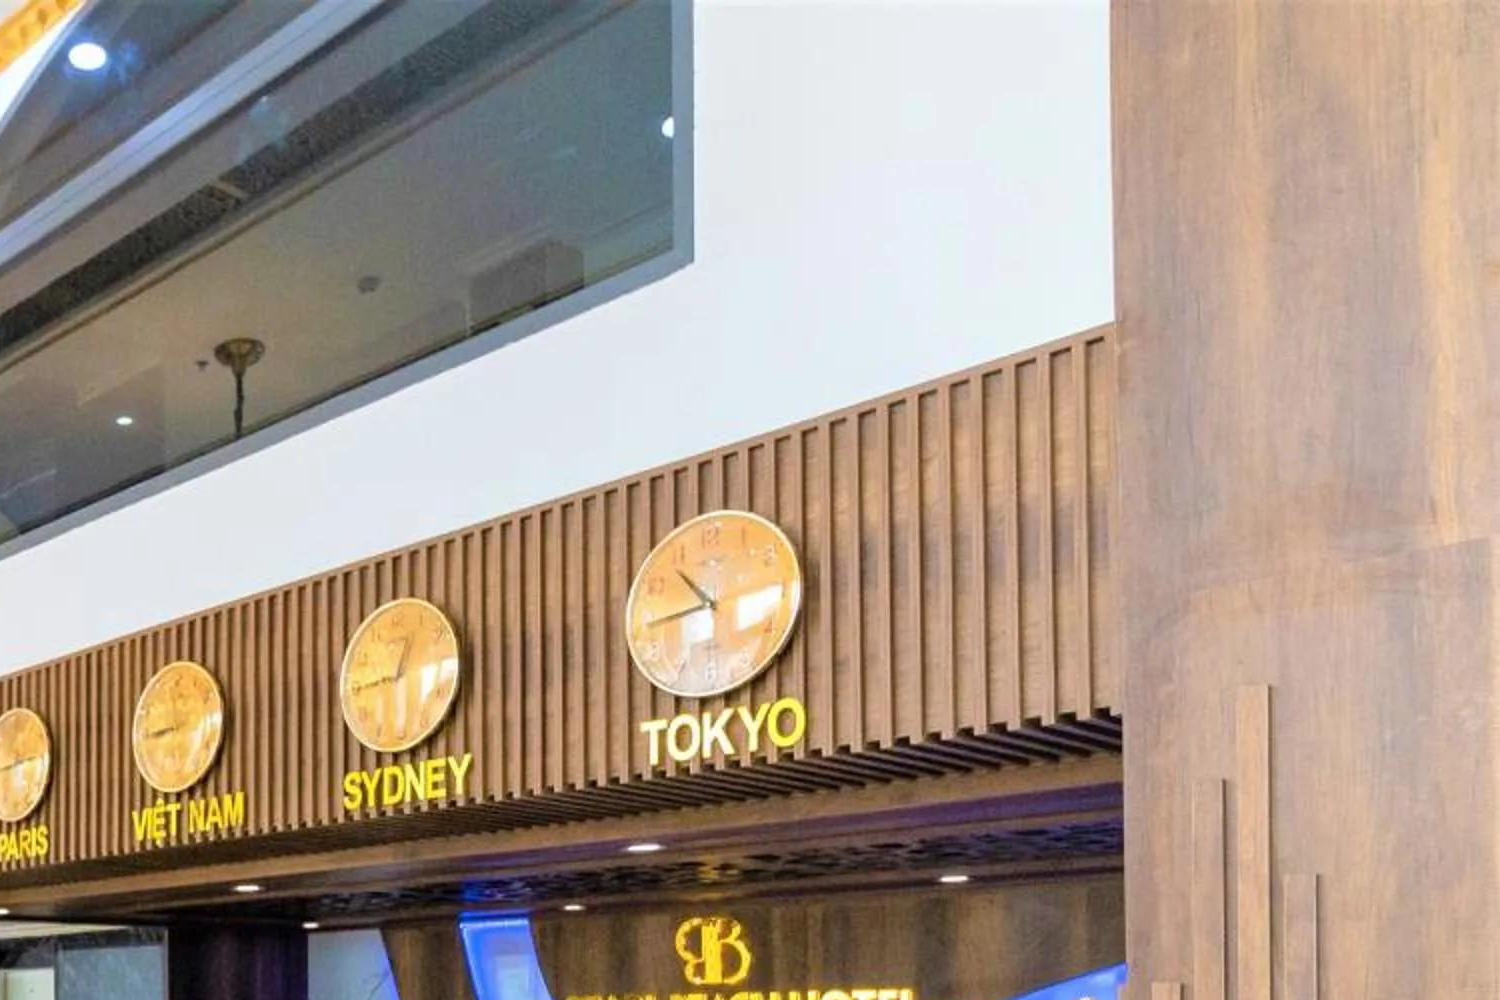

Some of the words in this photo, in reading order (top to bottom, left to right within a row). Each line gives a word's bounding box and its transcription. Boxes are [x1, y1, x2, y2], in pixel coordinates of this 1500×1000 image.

[641, 697, 805, 765] TOKYO
[343, 753, 472, 811] SYDNEY
[132, 798, 181, 845] VIỆT
[189, 792, 244, 833] NAM
